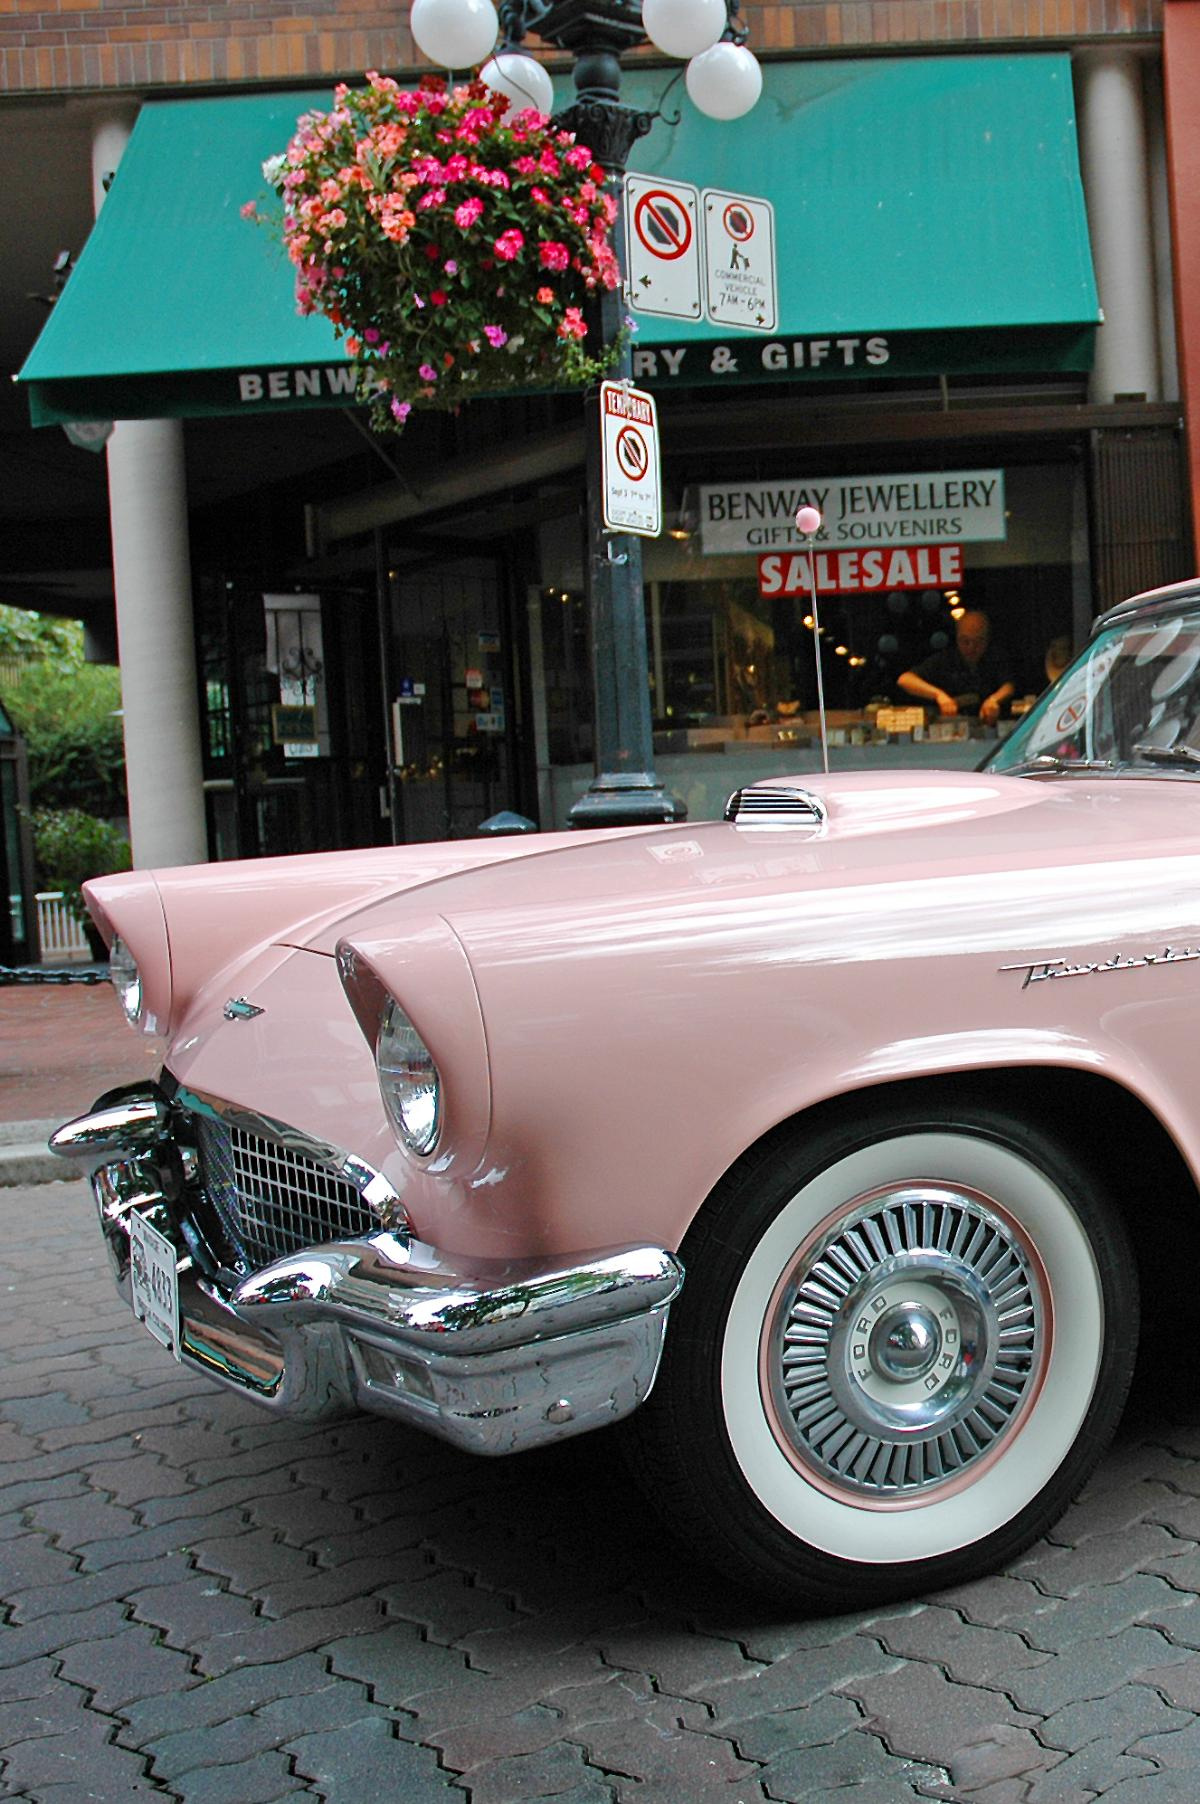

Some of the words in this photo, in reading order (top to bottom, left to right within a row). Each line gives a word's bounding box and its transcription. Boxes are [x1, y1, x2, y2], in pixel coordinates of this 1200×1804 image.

[714, 269, 766, 286] COMMERCIAL
[710, 346, 738, 374] &
[761, 337, 890, 370] GIFTS
[708, 488, 829, 521] BENWAY
[837, 479, 997, 519] JEWELLERY
[746, 524, 809, 545] GIFTS
[837, 517, 962, 540] SOUVENIRS
